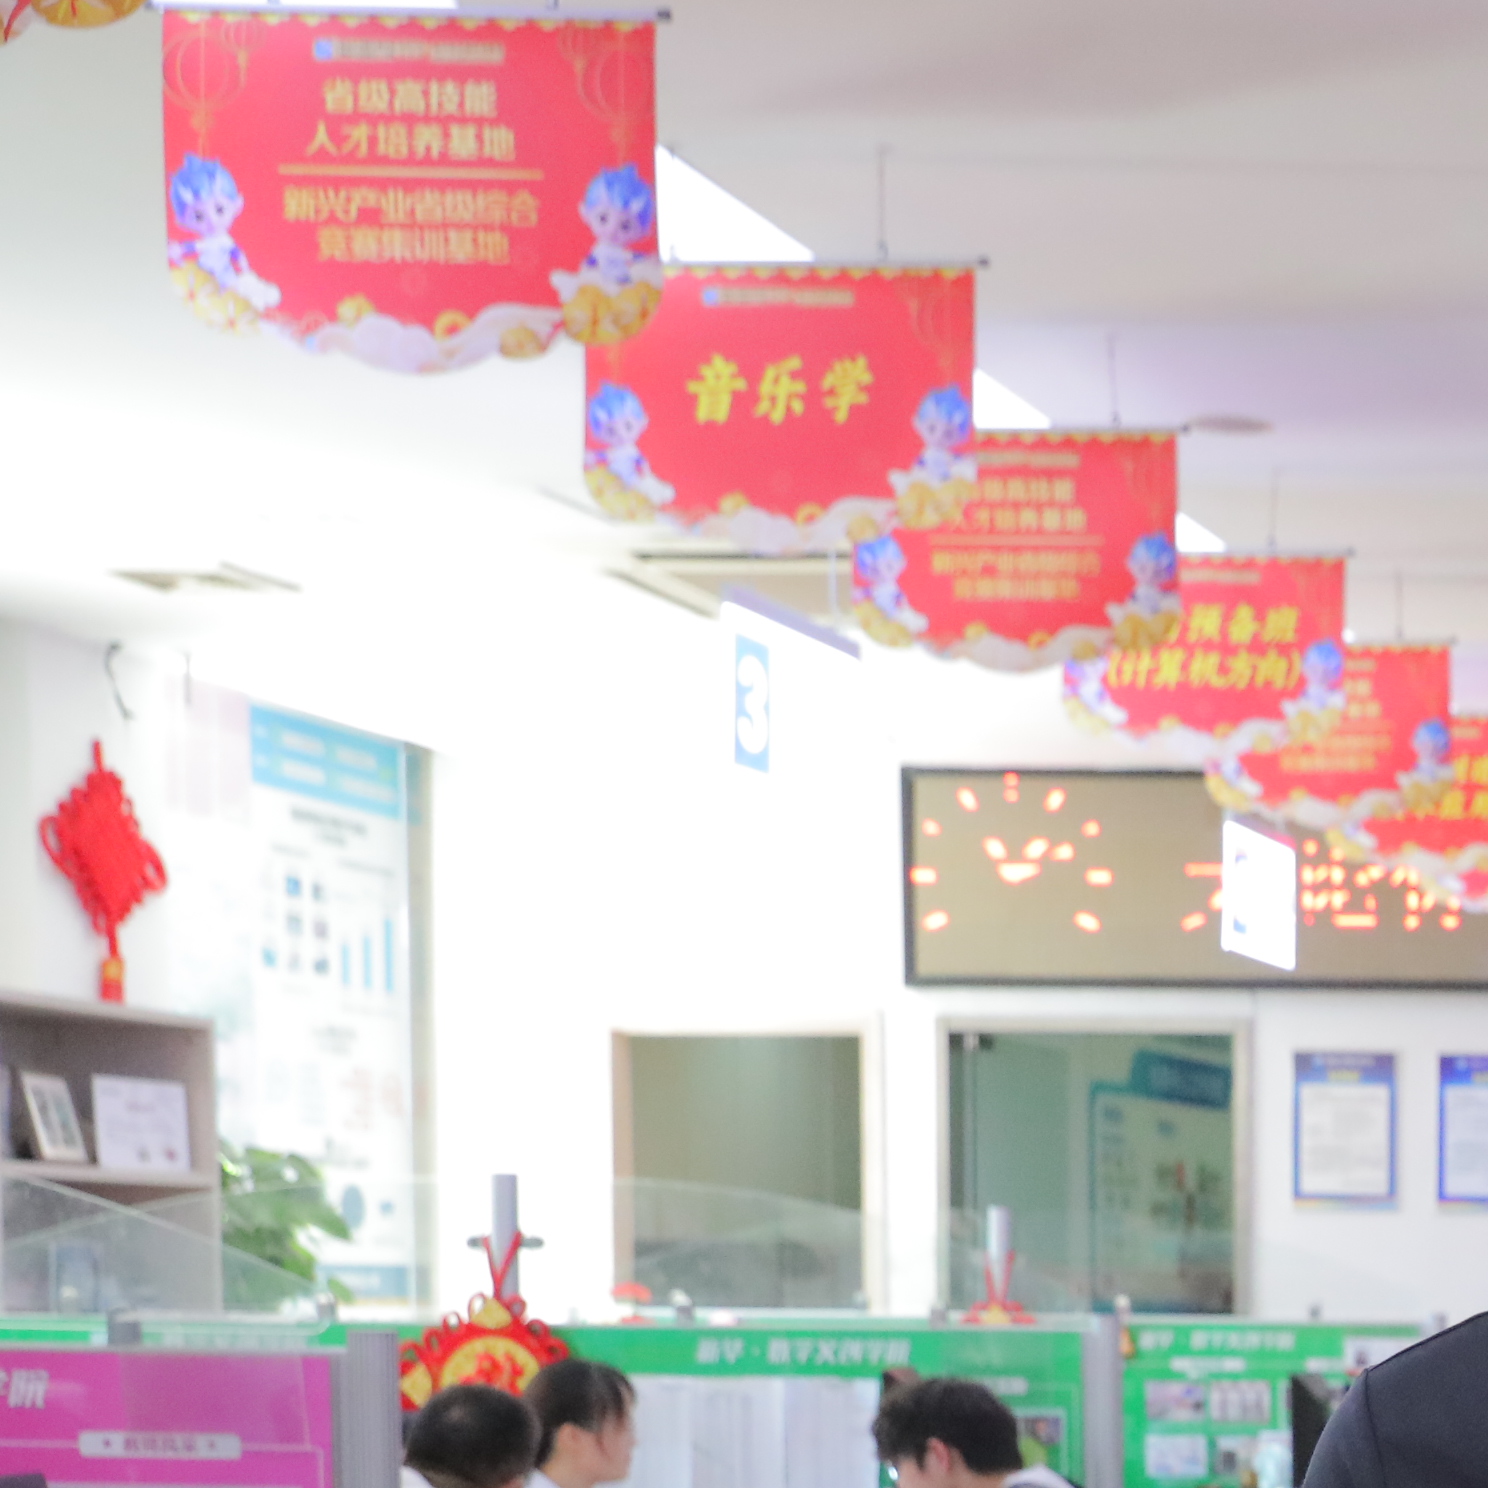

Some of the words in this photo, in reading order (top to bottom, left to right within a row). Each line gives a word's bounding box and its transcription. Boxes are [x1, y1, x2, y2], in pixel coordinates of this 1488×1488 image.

[305, 119, 517, 162] 人才培养基地
[686, 353, 874, 425] 音乐学
